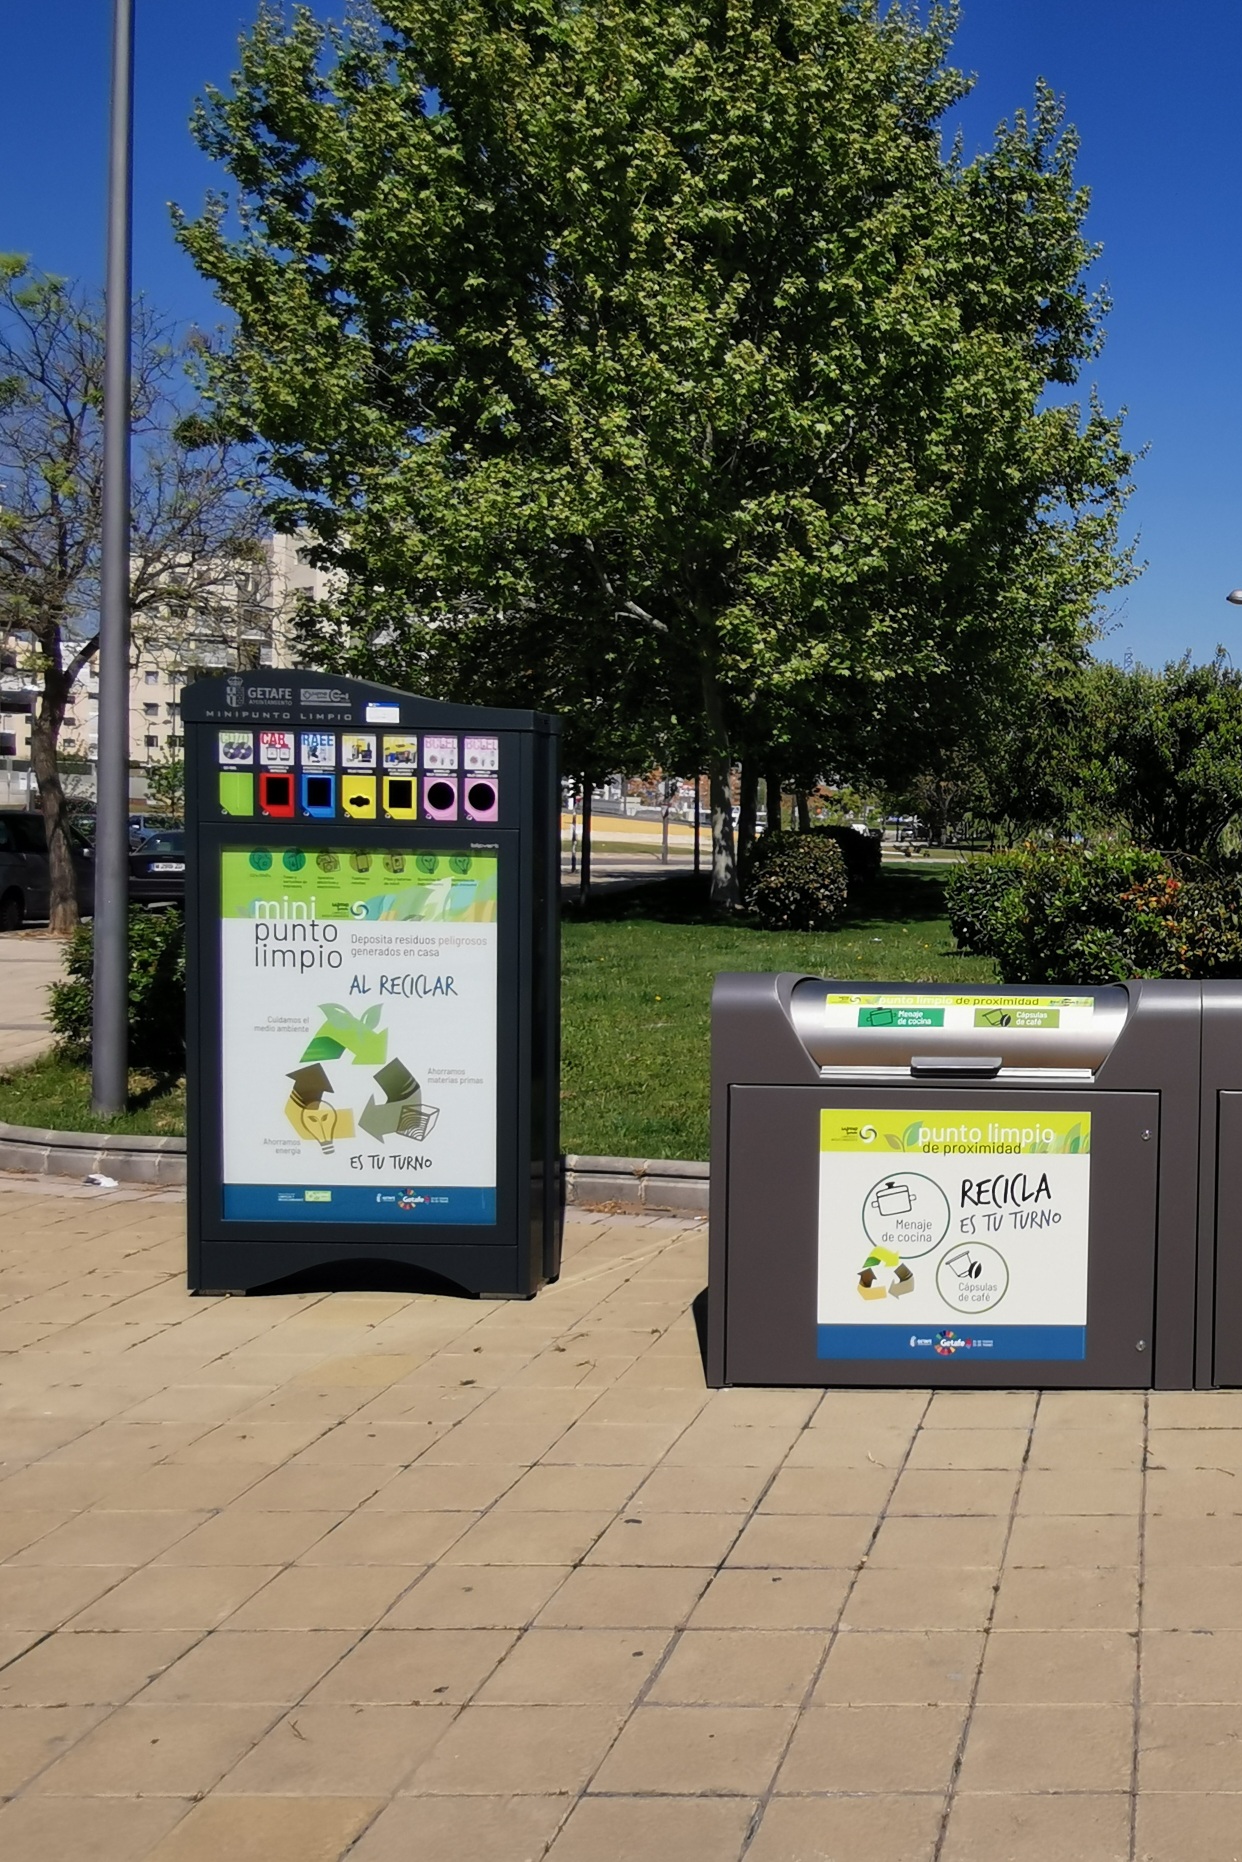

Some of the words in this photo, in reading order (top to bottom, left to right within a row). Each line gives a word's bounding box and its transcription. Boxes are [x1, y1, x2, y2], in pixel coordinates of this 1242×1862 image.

[248, 687, 292, 699] GETAFE
[206, 710, 290, 719] MINIPUNTO
[262, 732, 285, 744] CAR
[302, 734, 333, 746] RAEE
[254, 895, 316, 920] mini
[254, 920, 338, 944] punto
[350, 934, 393, 947] Deposita
[395, 935, 436, 946] residuos
[438, 936, 488, 948] peligrosos
[350, 947, 401, 958] generados
[417, 949, 440, 957] casa
[254, 945, 343, 974] limpio
[349, 974, 371, 996] AL
[379, 973, 458, 999] RECICLAR
[878, 996, 914, 1006] punto
[917, 995, 953, 1006] limpio
[956, 997, 970, 1005] de
[973, 997, 1039, 1006] proximidad
[267, 1016, 302, 1024] Cuidamos
[303, 1016, 310, 1024] el
[898, 1010, 923, 1018] Menaje
[1026, 1018, 1042, 1026] café
[277, 1025, 309, 1033] ambiente
[460, 1077, 484, 1086] primas
[918, 1124, 982, 1146] punto
[987, 1123, 1054, 1147] limpio
[263, 1138, 301, 1146] Ahorramos
[922, 1142, 940, 1154] de
[943, 1142, 1022, 1156] proximidad
[350, 1154, 363, 1170] ES
[368, 1155, 385, 1170] TU
[389, 1155, 433, 1171] TURNO
[960, 1173, 1051, 1208] RECICLA
[896, 1219, 932, 1231] Menaje
[960, 1214, 976, 1235] ES
[982, 1212, 1003, 1232] TU
[1008, 1209, 1062, 1231] TURNO
[882, 1232, 895, 1243] de
[898, 1232, 932, 1243] cocina
[958, 1282, 998, 1294] Cápsulas
[958, 1292, 969, 1302] de
[971, 1292, 990, 1302] café
